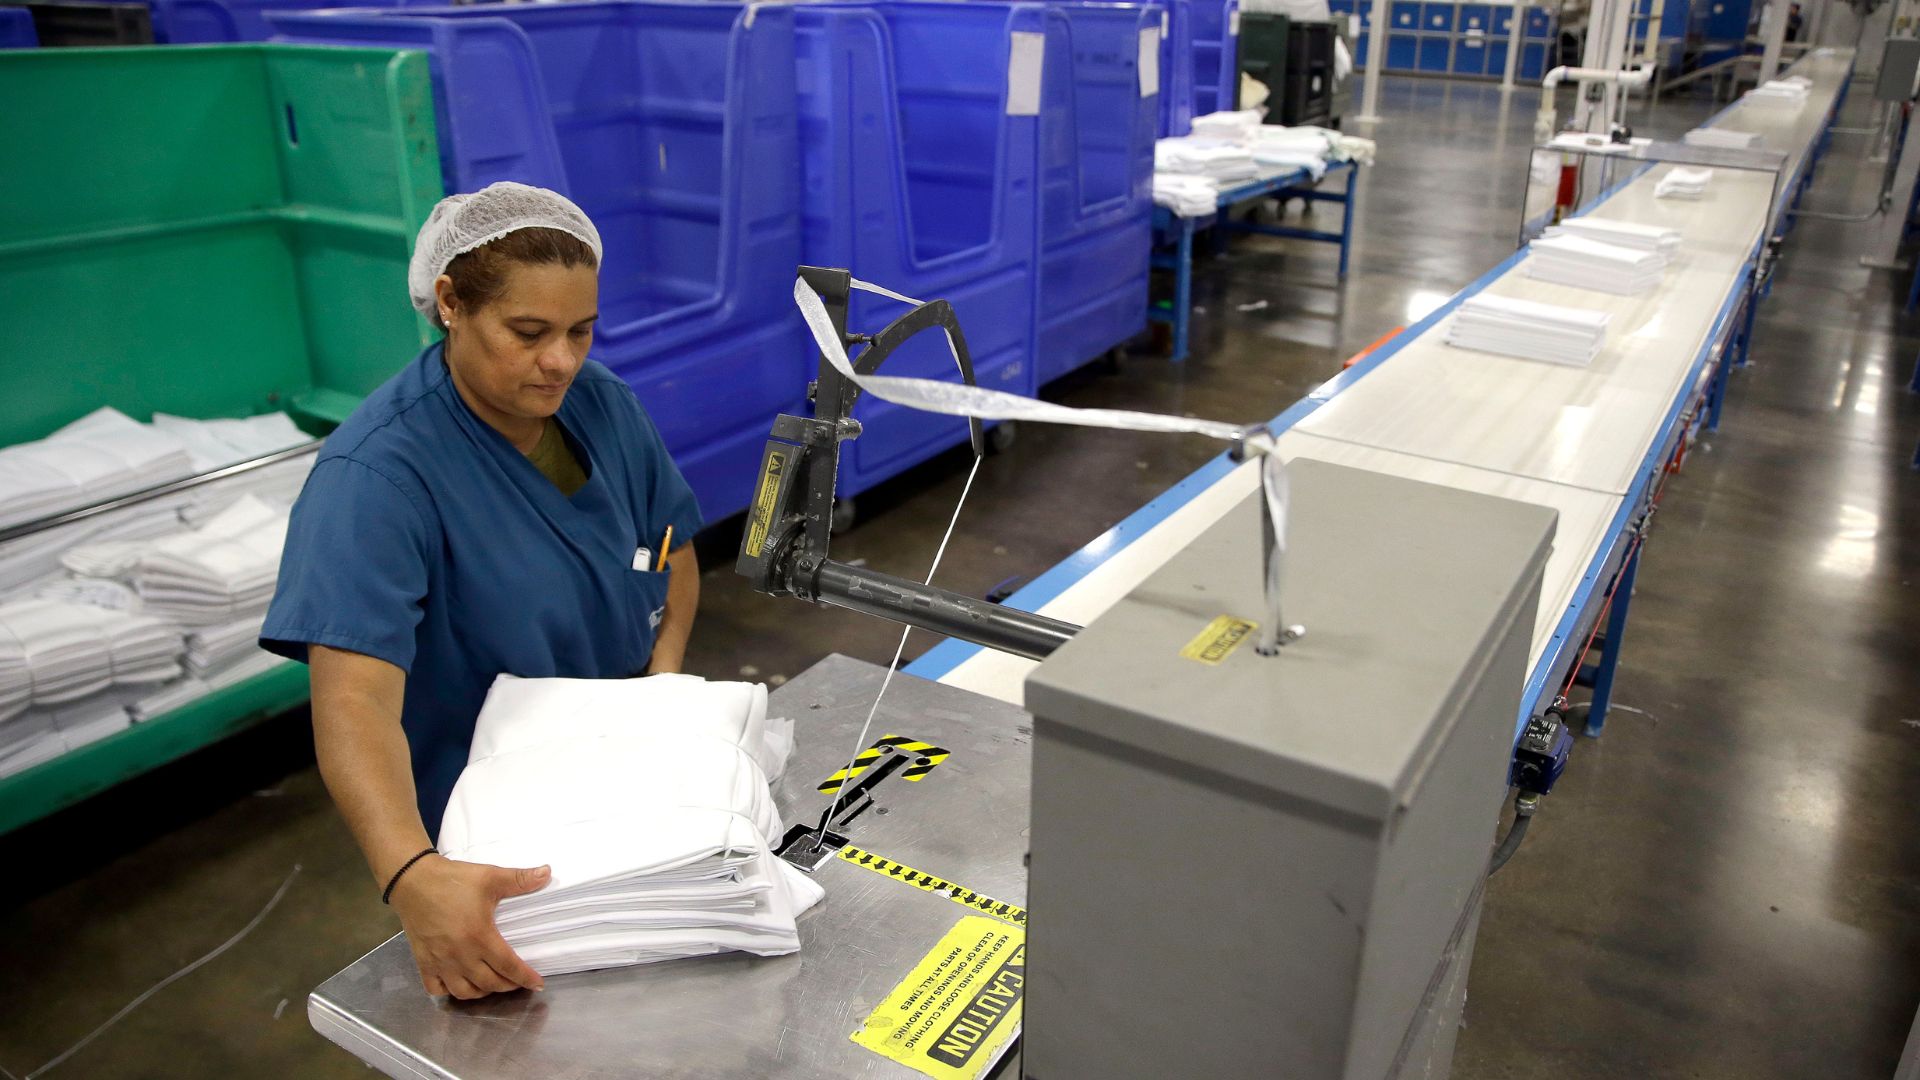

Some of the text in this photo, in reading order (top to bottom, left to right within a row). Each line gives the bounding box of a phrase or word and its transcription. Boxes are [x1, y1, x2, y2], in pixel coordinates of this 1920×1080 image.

[893, 932, 994, 1039] CLEAR OF OPENINGS AND MOVING
[900, 947, 962, 1011] PARTS AT ALL TIMES
[905, 934, 1009, 1048] KEEP HANDS AND LOOSE CLOTHING
[938, 970, 1024, 1058] CAUTION
